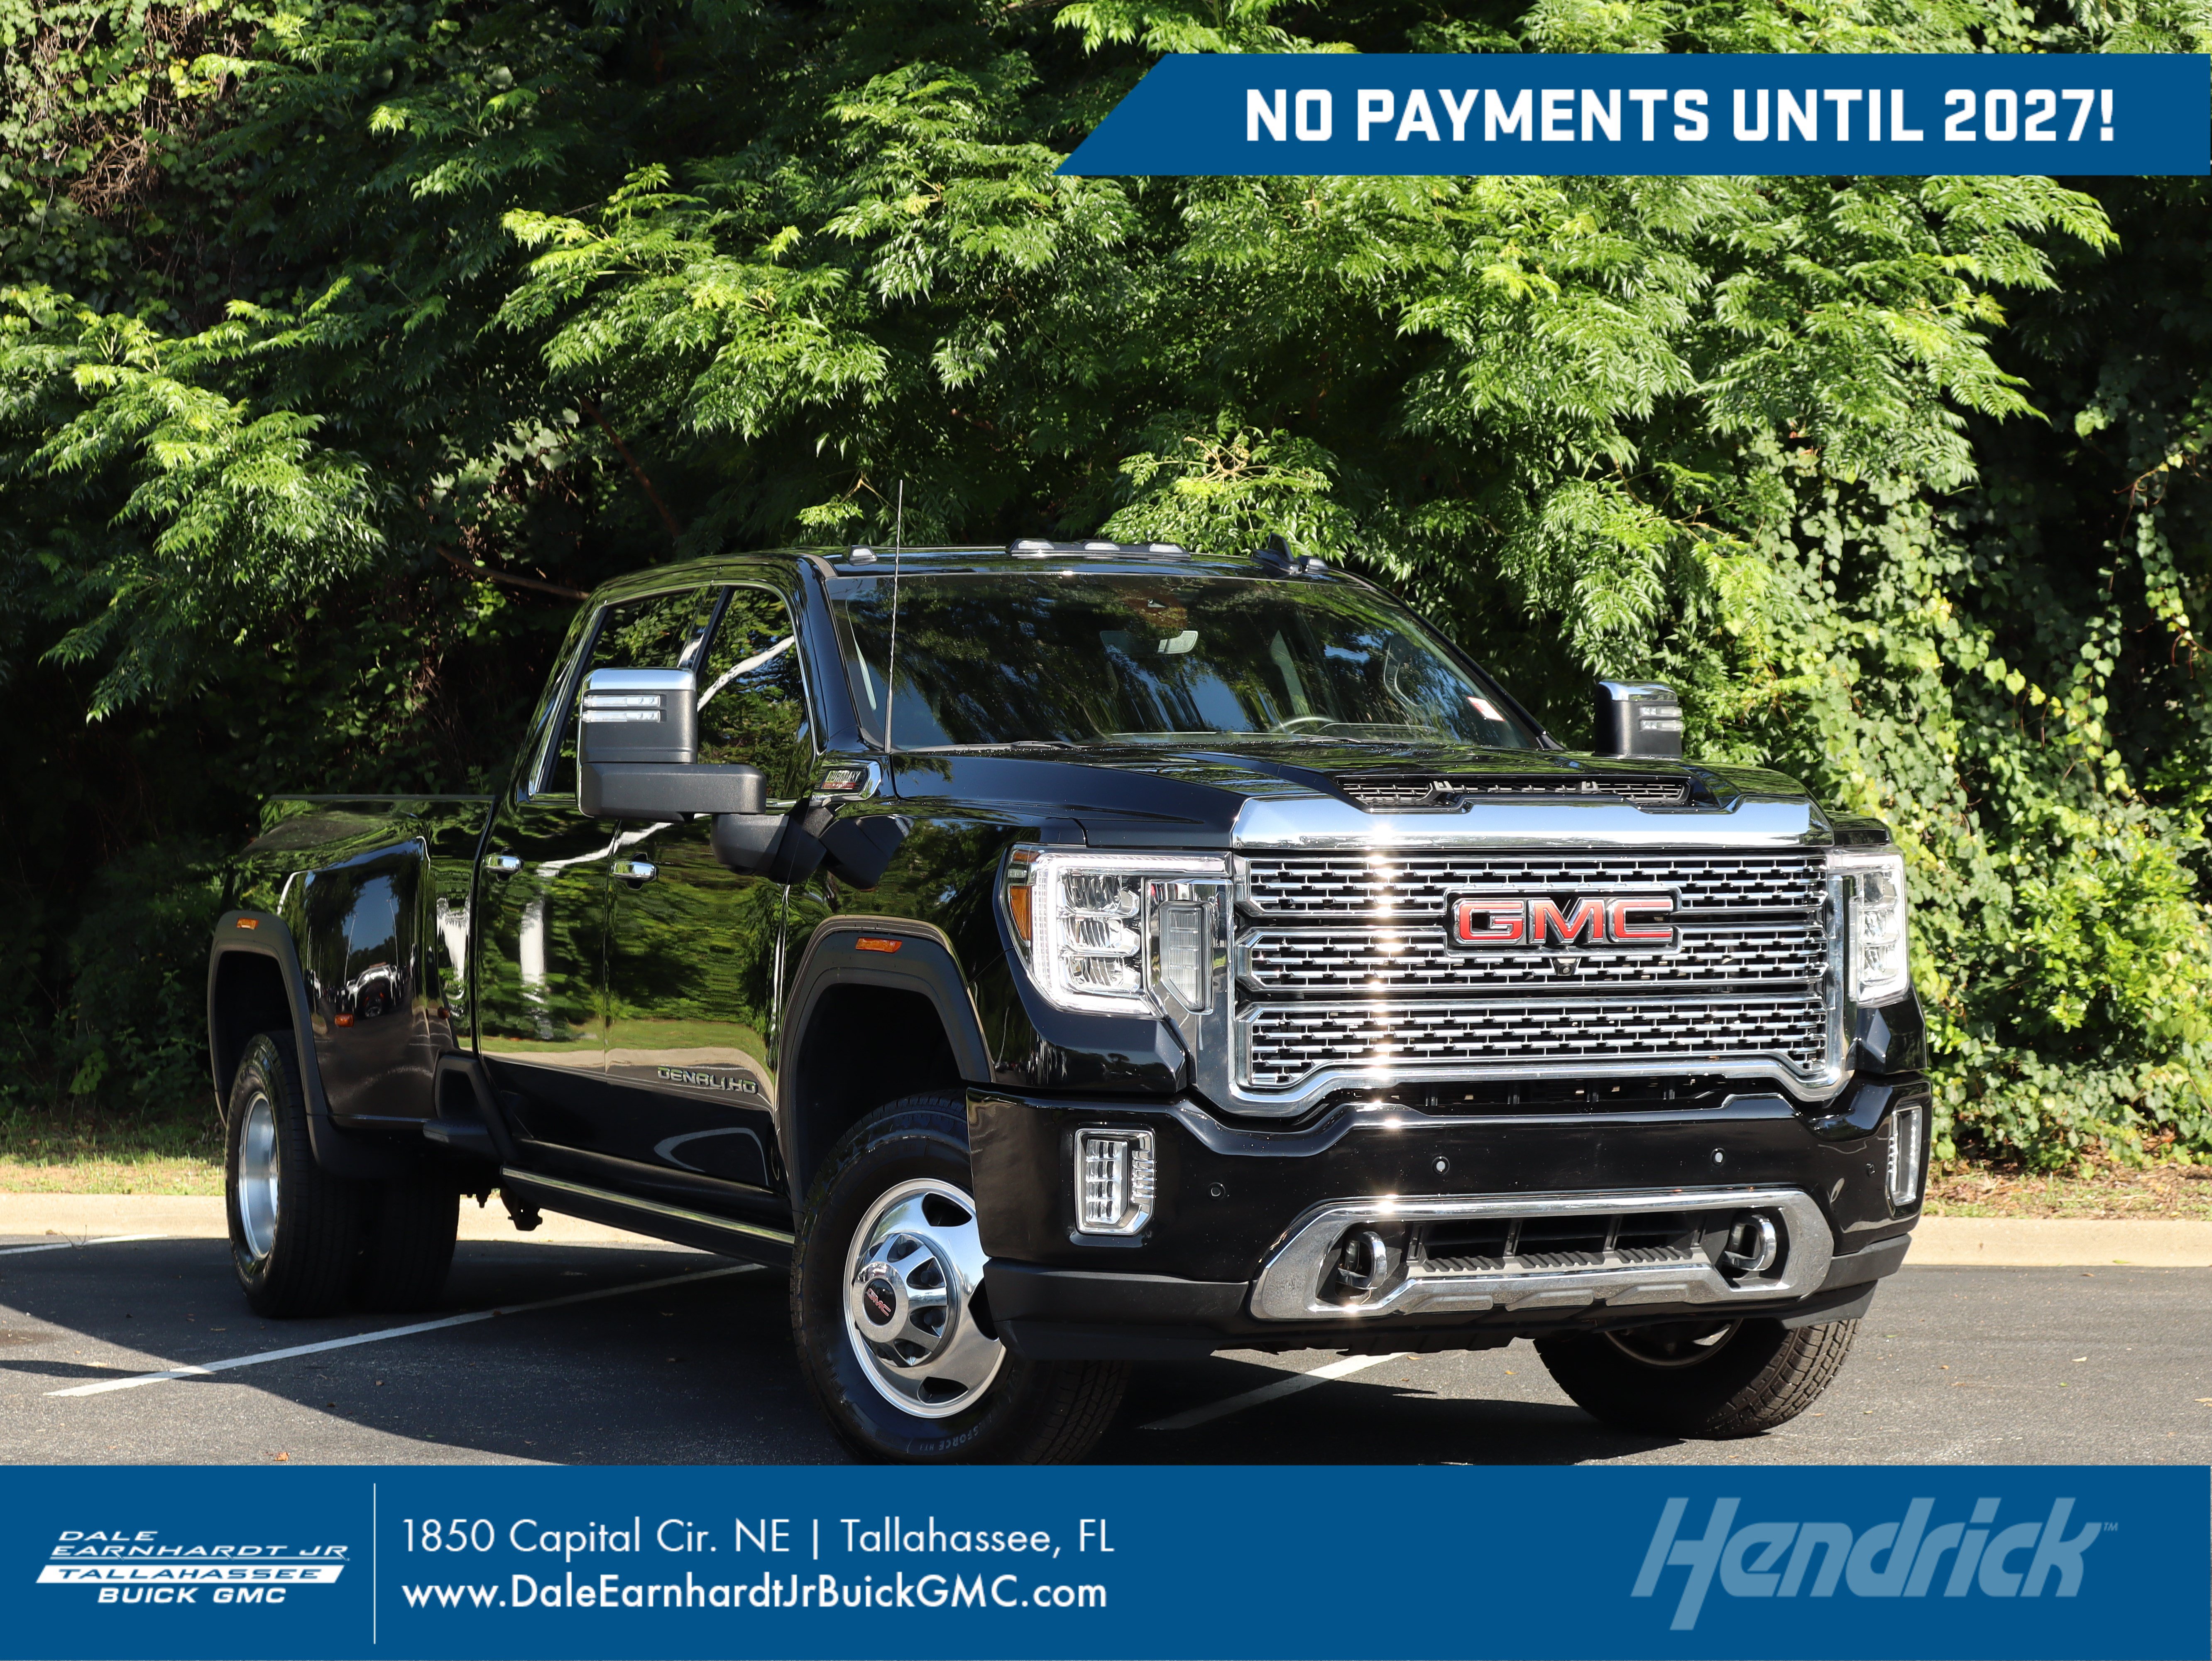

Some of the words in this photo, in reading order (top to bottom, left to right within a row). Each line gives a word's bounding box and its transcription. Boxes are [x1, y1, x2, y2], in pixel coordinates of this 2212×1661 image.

[1453, 897, 1674, 945] GMC
[658, 1067, 727, 1090] DENALI
[867, 1288, 891, 1316] GMC
